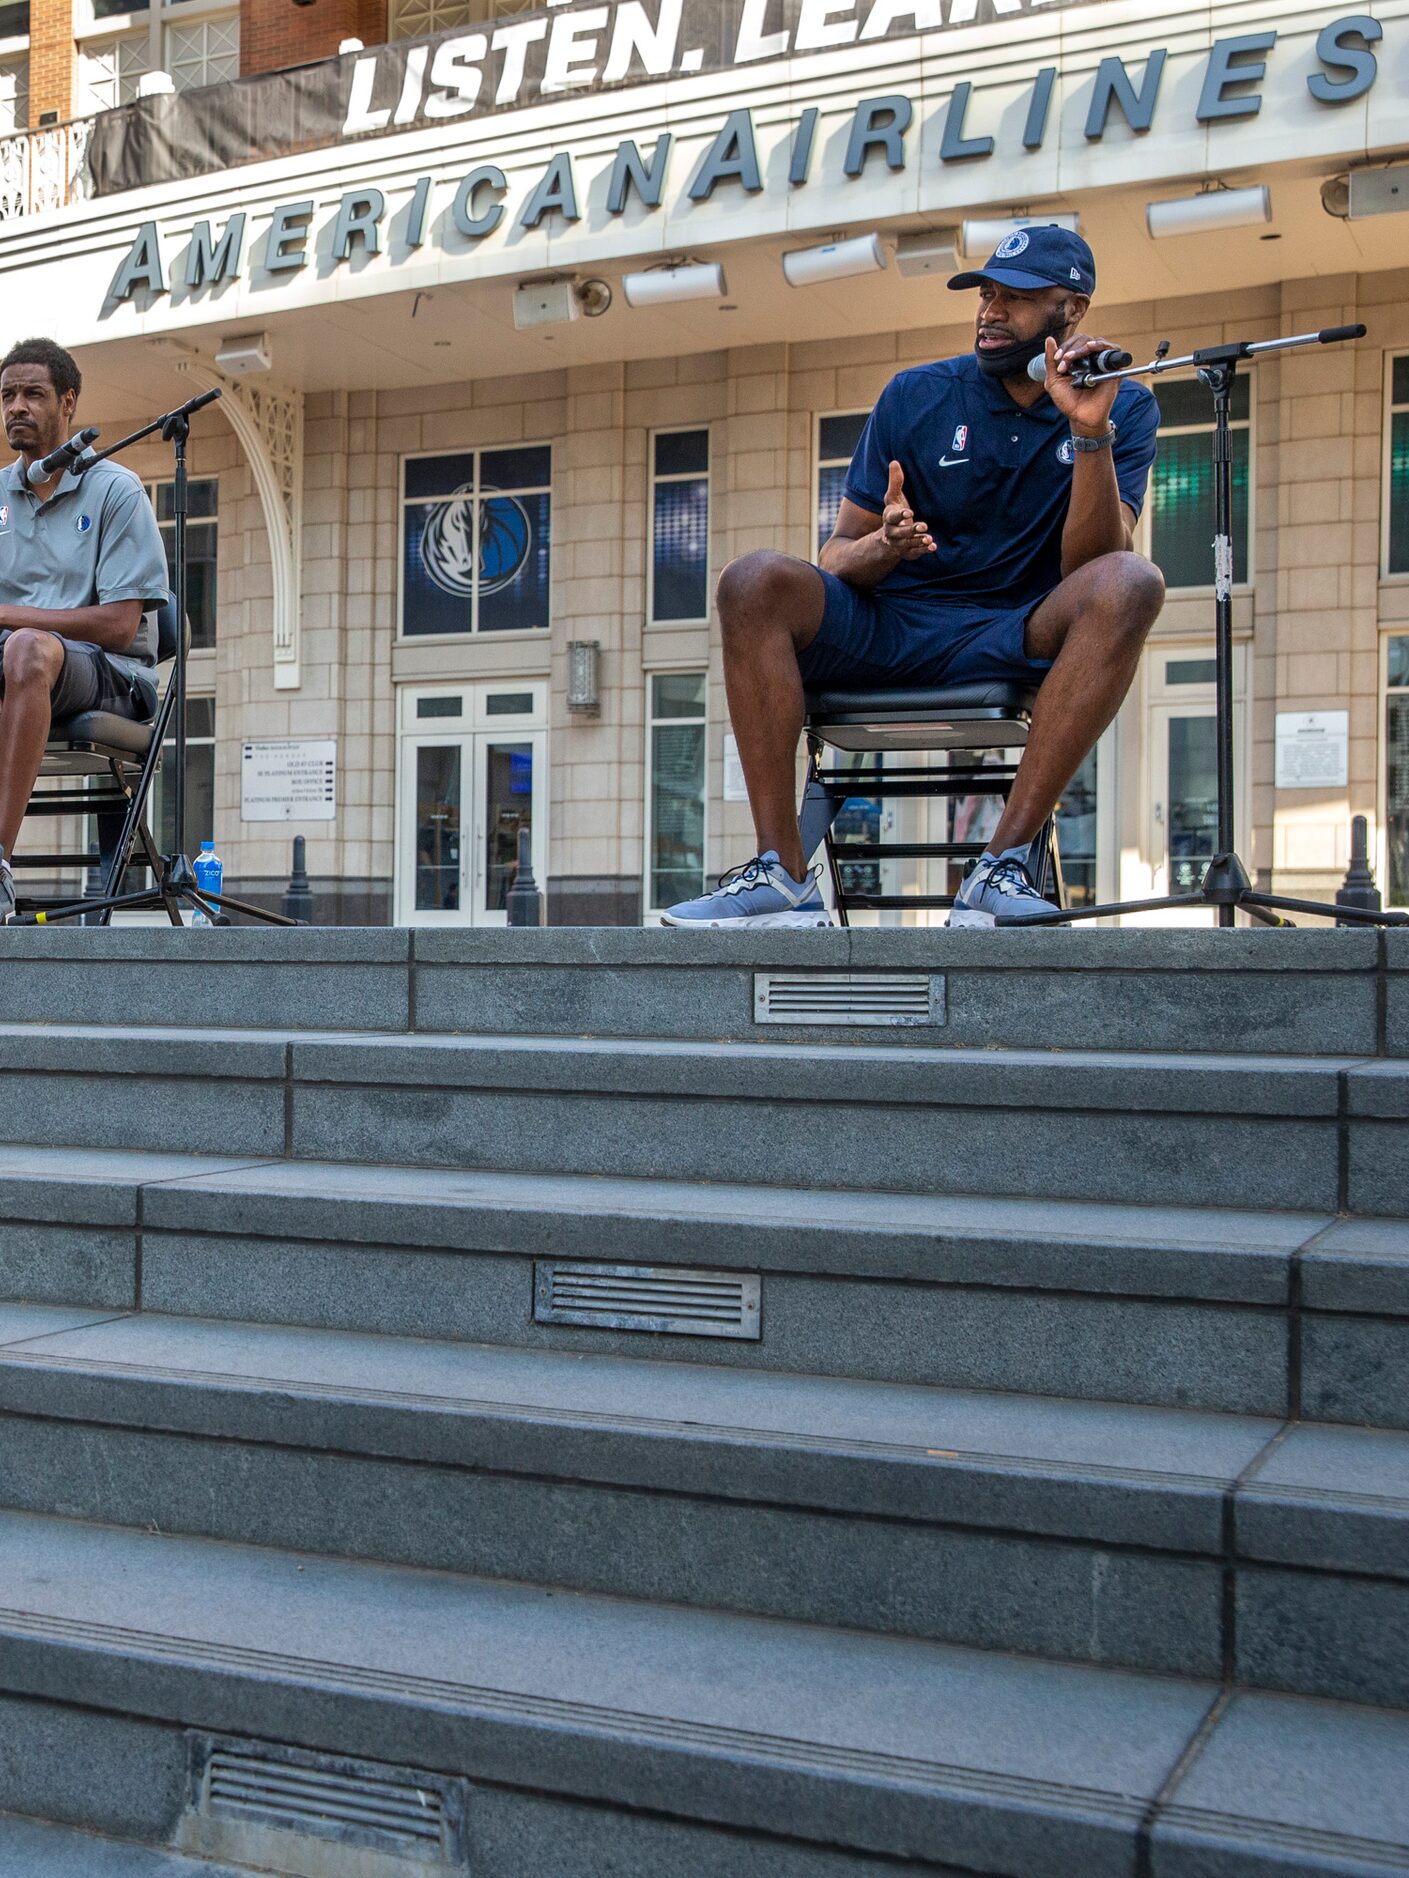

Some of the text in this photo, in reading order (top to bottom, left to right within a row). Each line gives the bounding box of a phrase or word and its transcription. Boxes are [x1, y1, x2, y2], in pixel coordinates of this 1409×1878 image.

[112, 15, 1383, 299] AMERICAN AIRLINES
[342, 0, 703, 136] LISTEN.
